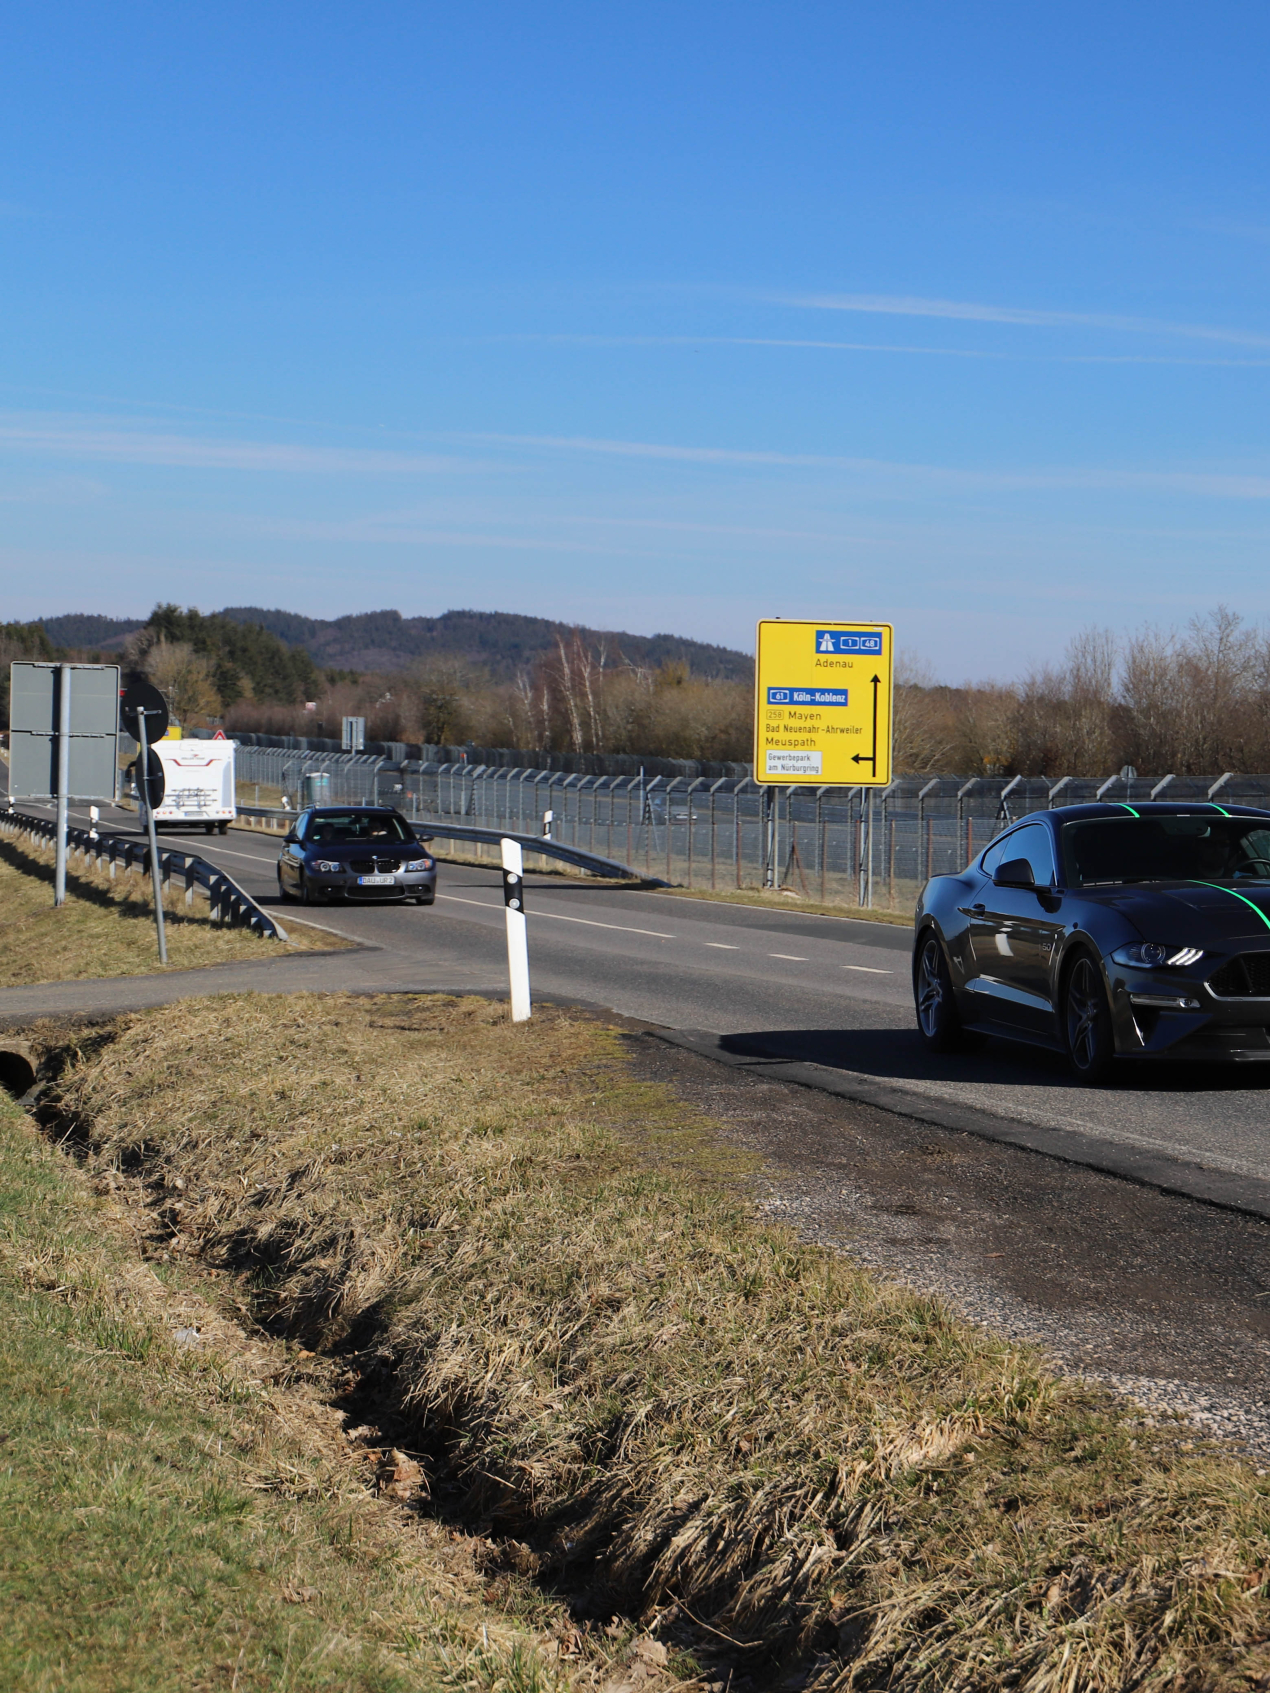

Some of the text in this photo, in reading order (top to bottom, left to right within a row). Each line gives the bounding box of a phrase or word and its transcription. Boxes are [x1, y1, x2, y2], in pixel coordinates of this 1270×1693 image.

[815, 659, 853, 668] Adenau
[775, 692, 784, 700] 61
[793, 691, 846, 703] Köln-Koblenz
[768, 711, 782, 719] 258
[788, 711, 821, 722] Mayen
[766, 723, 780, 733] Bad
[765, 737, 816, 748] Meuspath
[768, 753, 811, 763] Gewerbepark
[780, 763, 819, 774] Nürburgring
